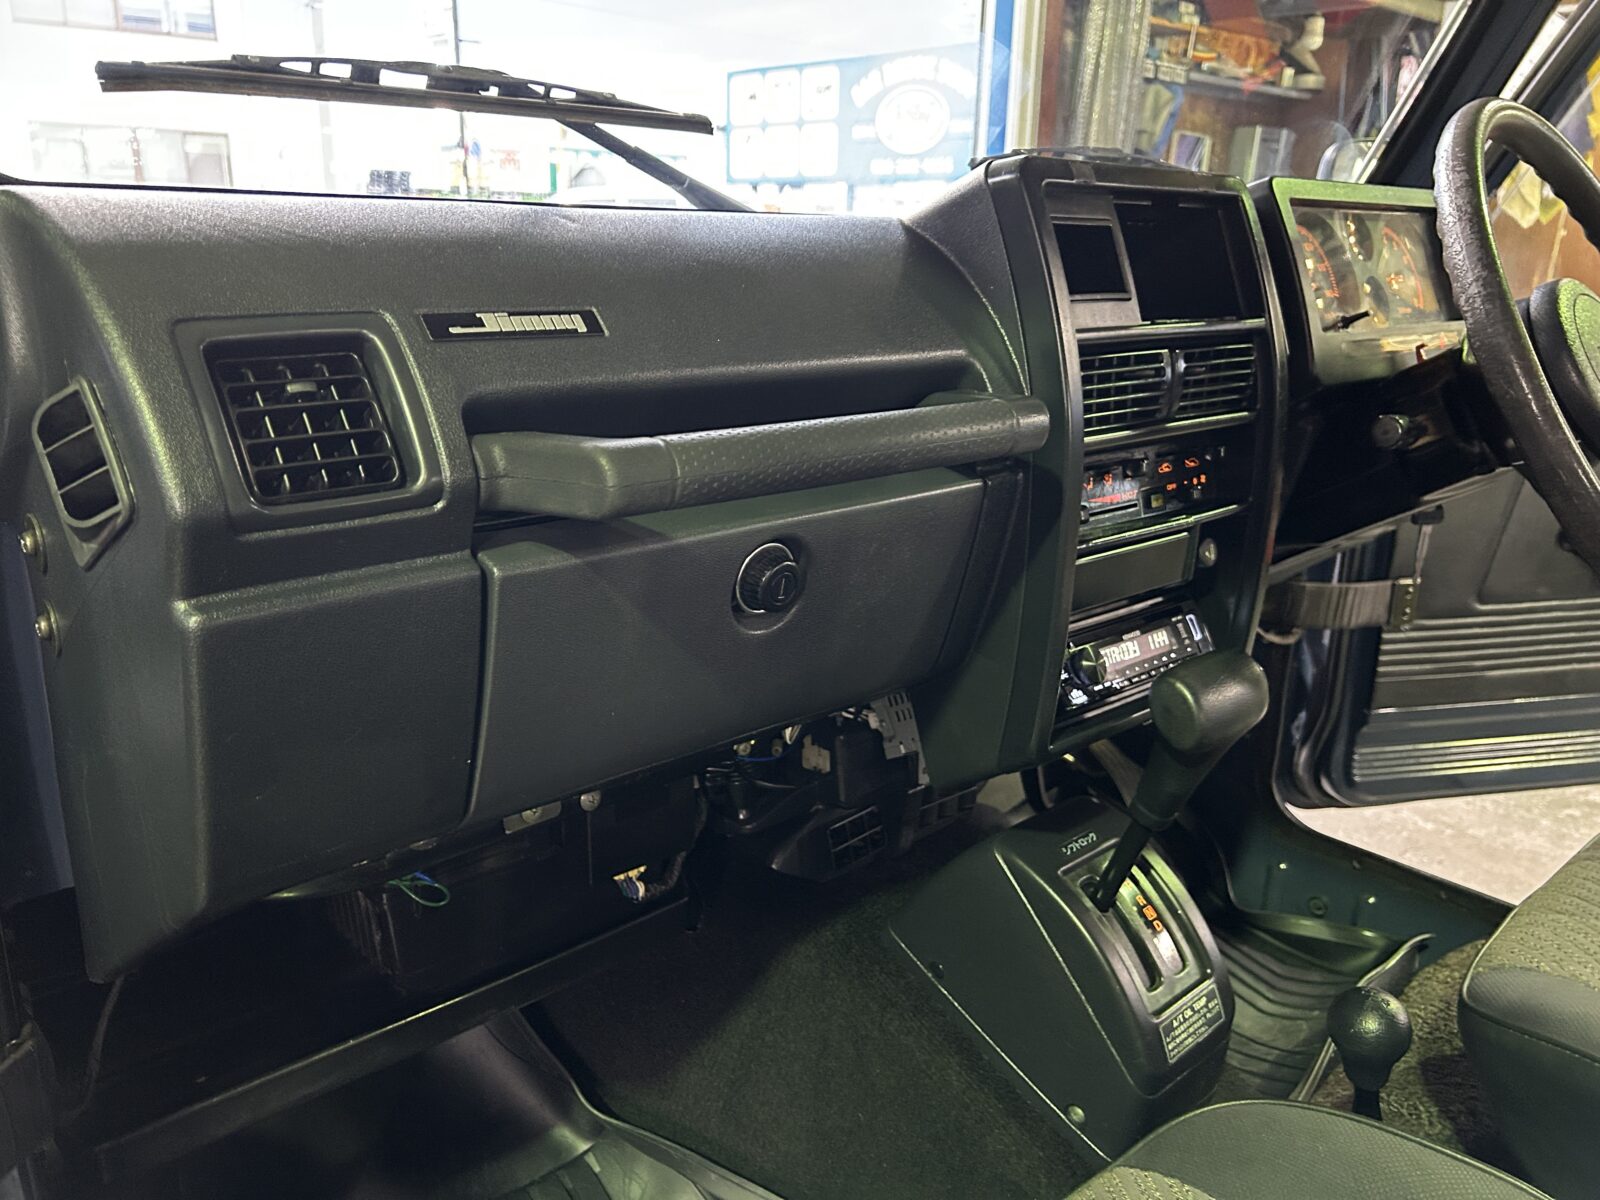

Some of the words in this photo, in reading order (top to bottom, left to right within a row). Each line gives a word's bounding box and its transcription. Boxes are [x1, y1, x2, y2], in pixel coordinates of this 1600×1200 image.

[1061, 832, 1097, 855] シフトロック
[1152, 920, 1163, 932] D
[1172, 1013, 1184, 1028] A/T
[1193, 996, 1207, 1011] TEMP
